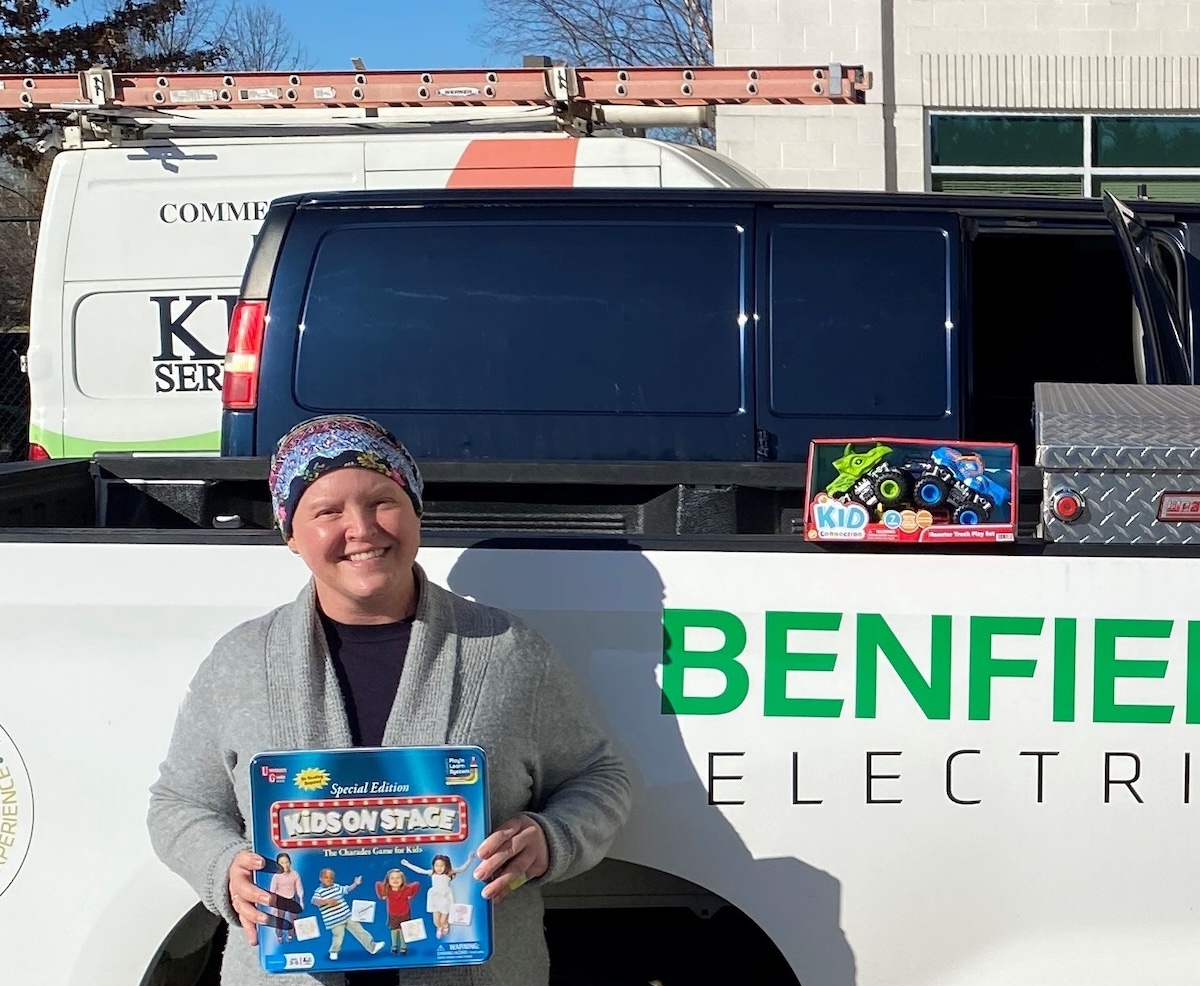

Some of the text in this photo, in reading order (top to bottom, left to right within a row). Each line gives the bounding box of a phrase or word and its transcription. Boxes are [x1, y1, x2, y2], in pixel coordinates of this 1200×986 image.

[817, 505, 866, 528] KID
[330, 781, 410, 797] Special Edition
[342, 808, 379, 833] ON
[380, 806, 457, 831] STAGE
[339, 847, 371, 855] Charades
[373, 847, 393, 855] Game
[394, 846, 404, 854] for
[406, 845, 423, 854] Kids
